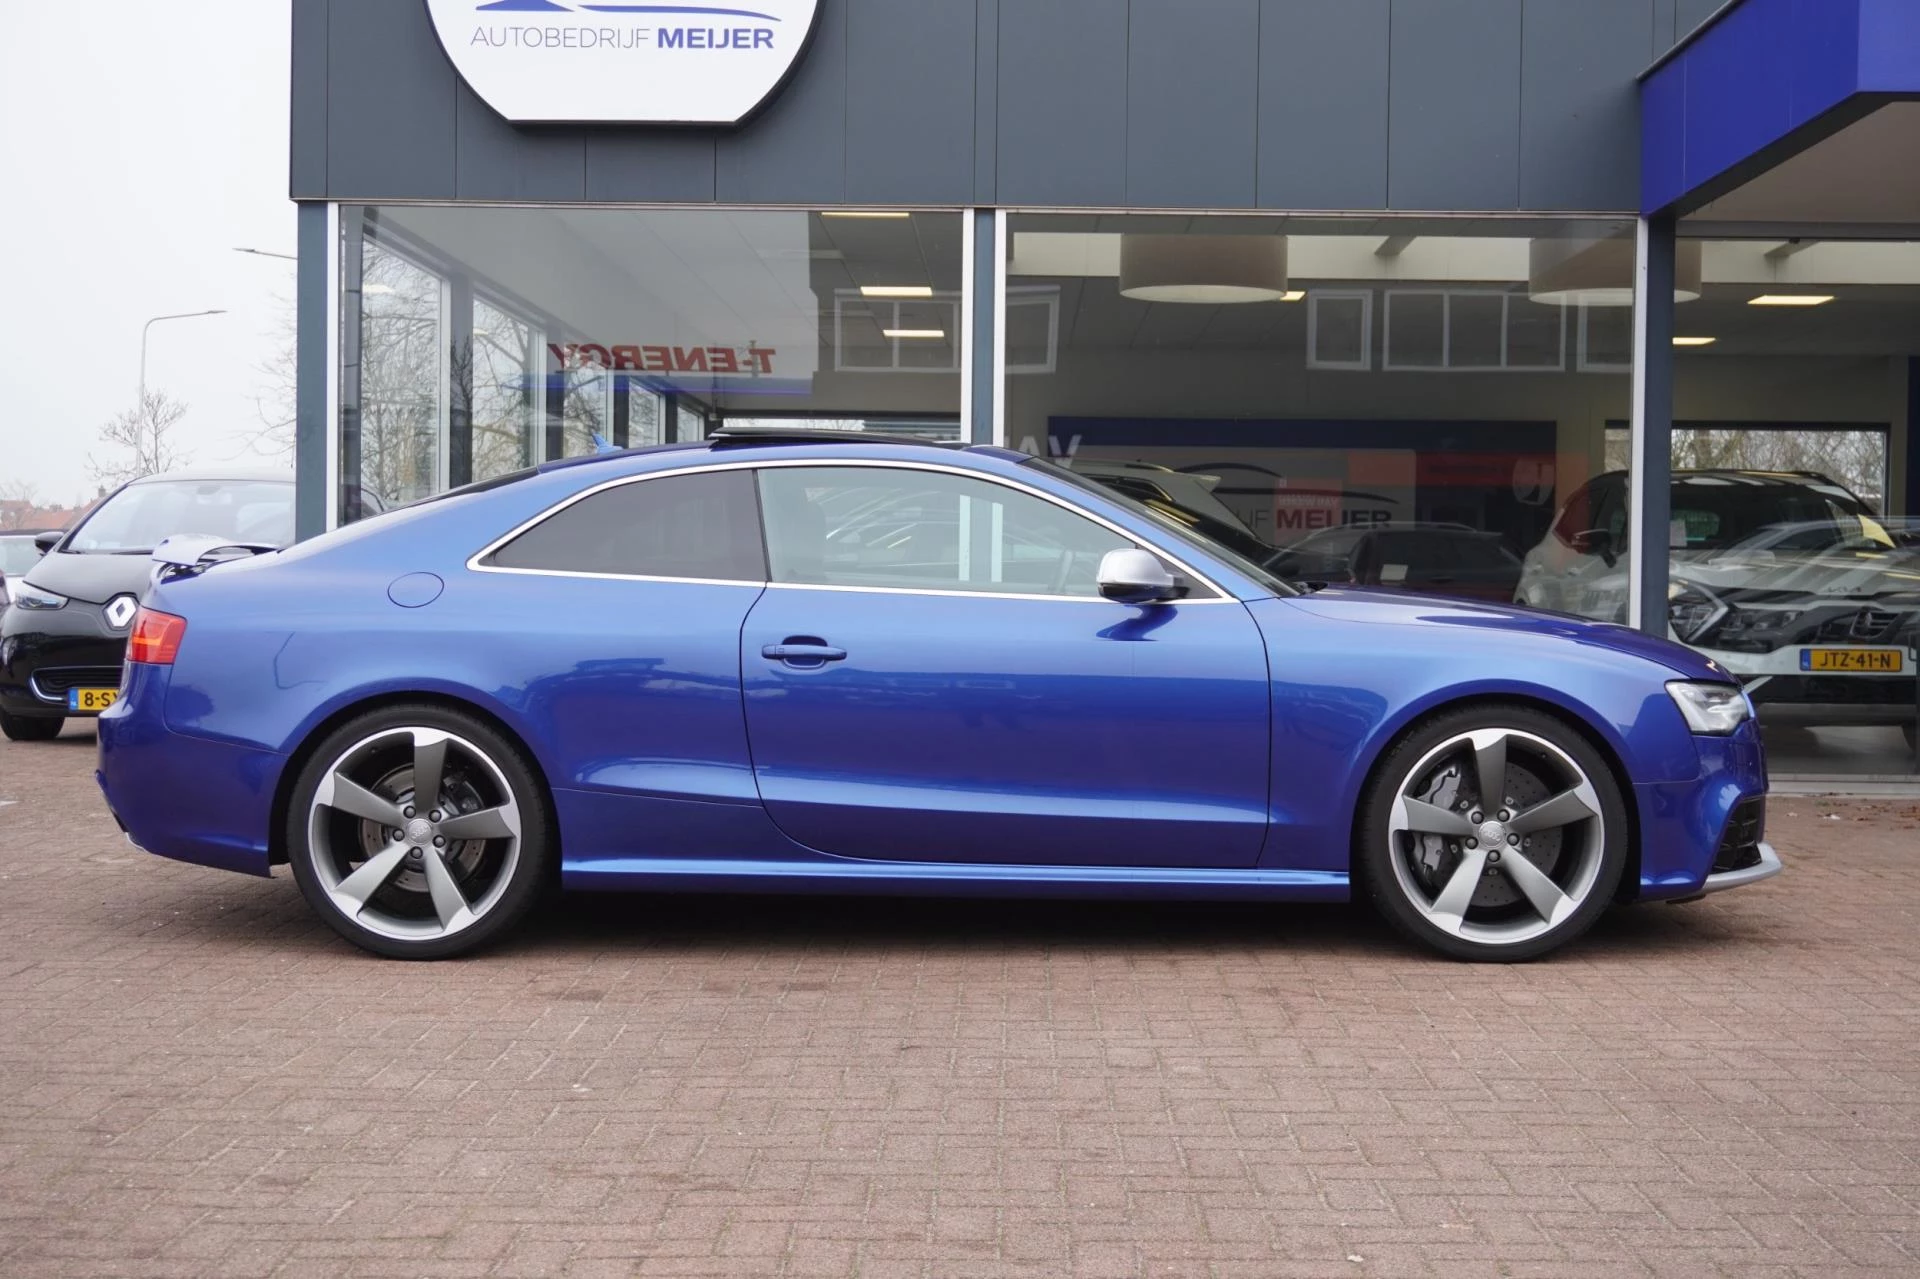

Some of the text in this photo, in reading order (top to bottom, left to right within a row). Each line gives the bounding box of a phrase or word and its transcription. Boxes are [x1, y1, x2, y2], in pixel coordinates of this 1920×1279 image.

[470, 26, 774, 49] AUTOBEDRIJF MEIJER
[1276, 508, 1392, 529] MEIJER
[1819, 651, 1891, 668] JTZ-41-N
